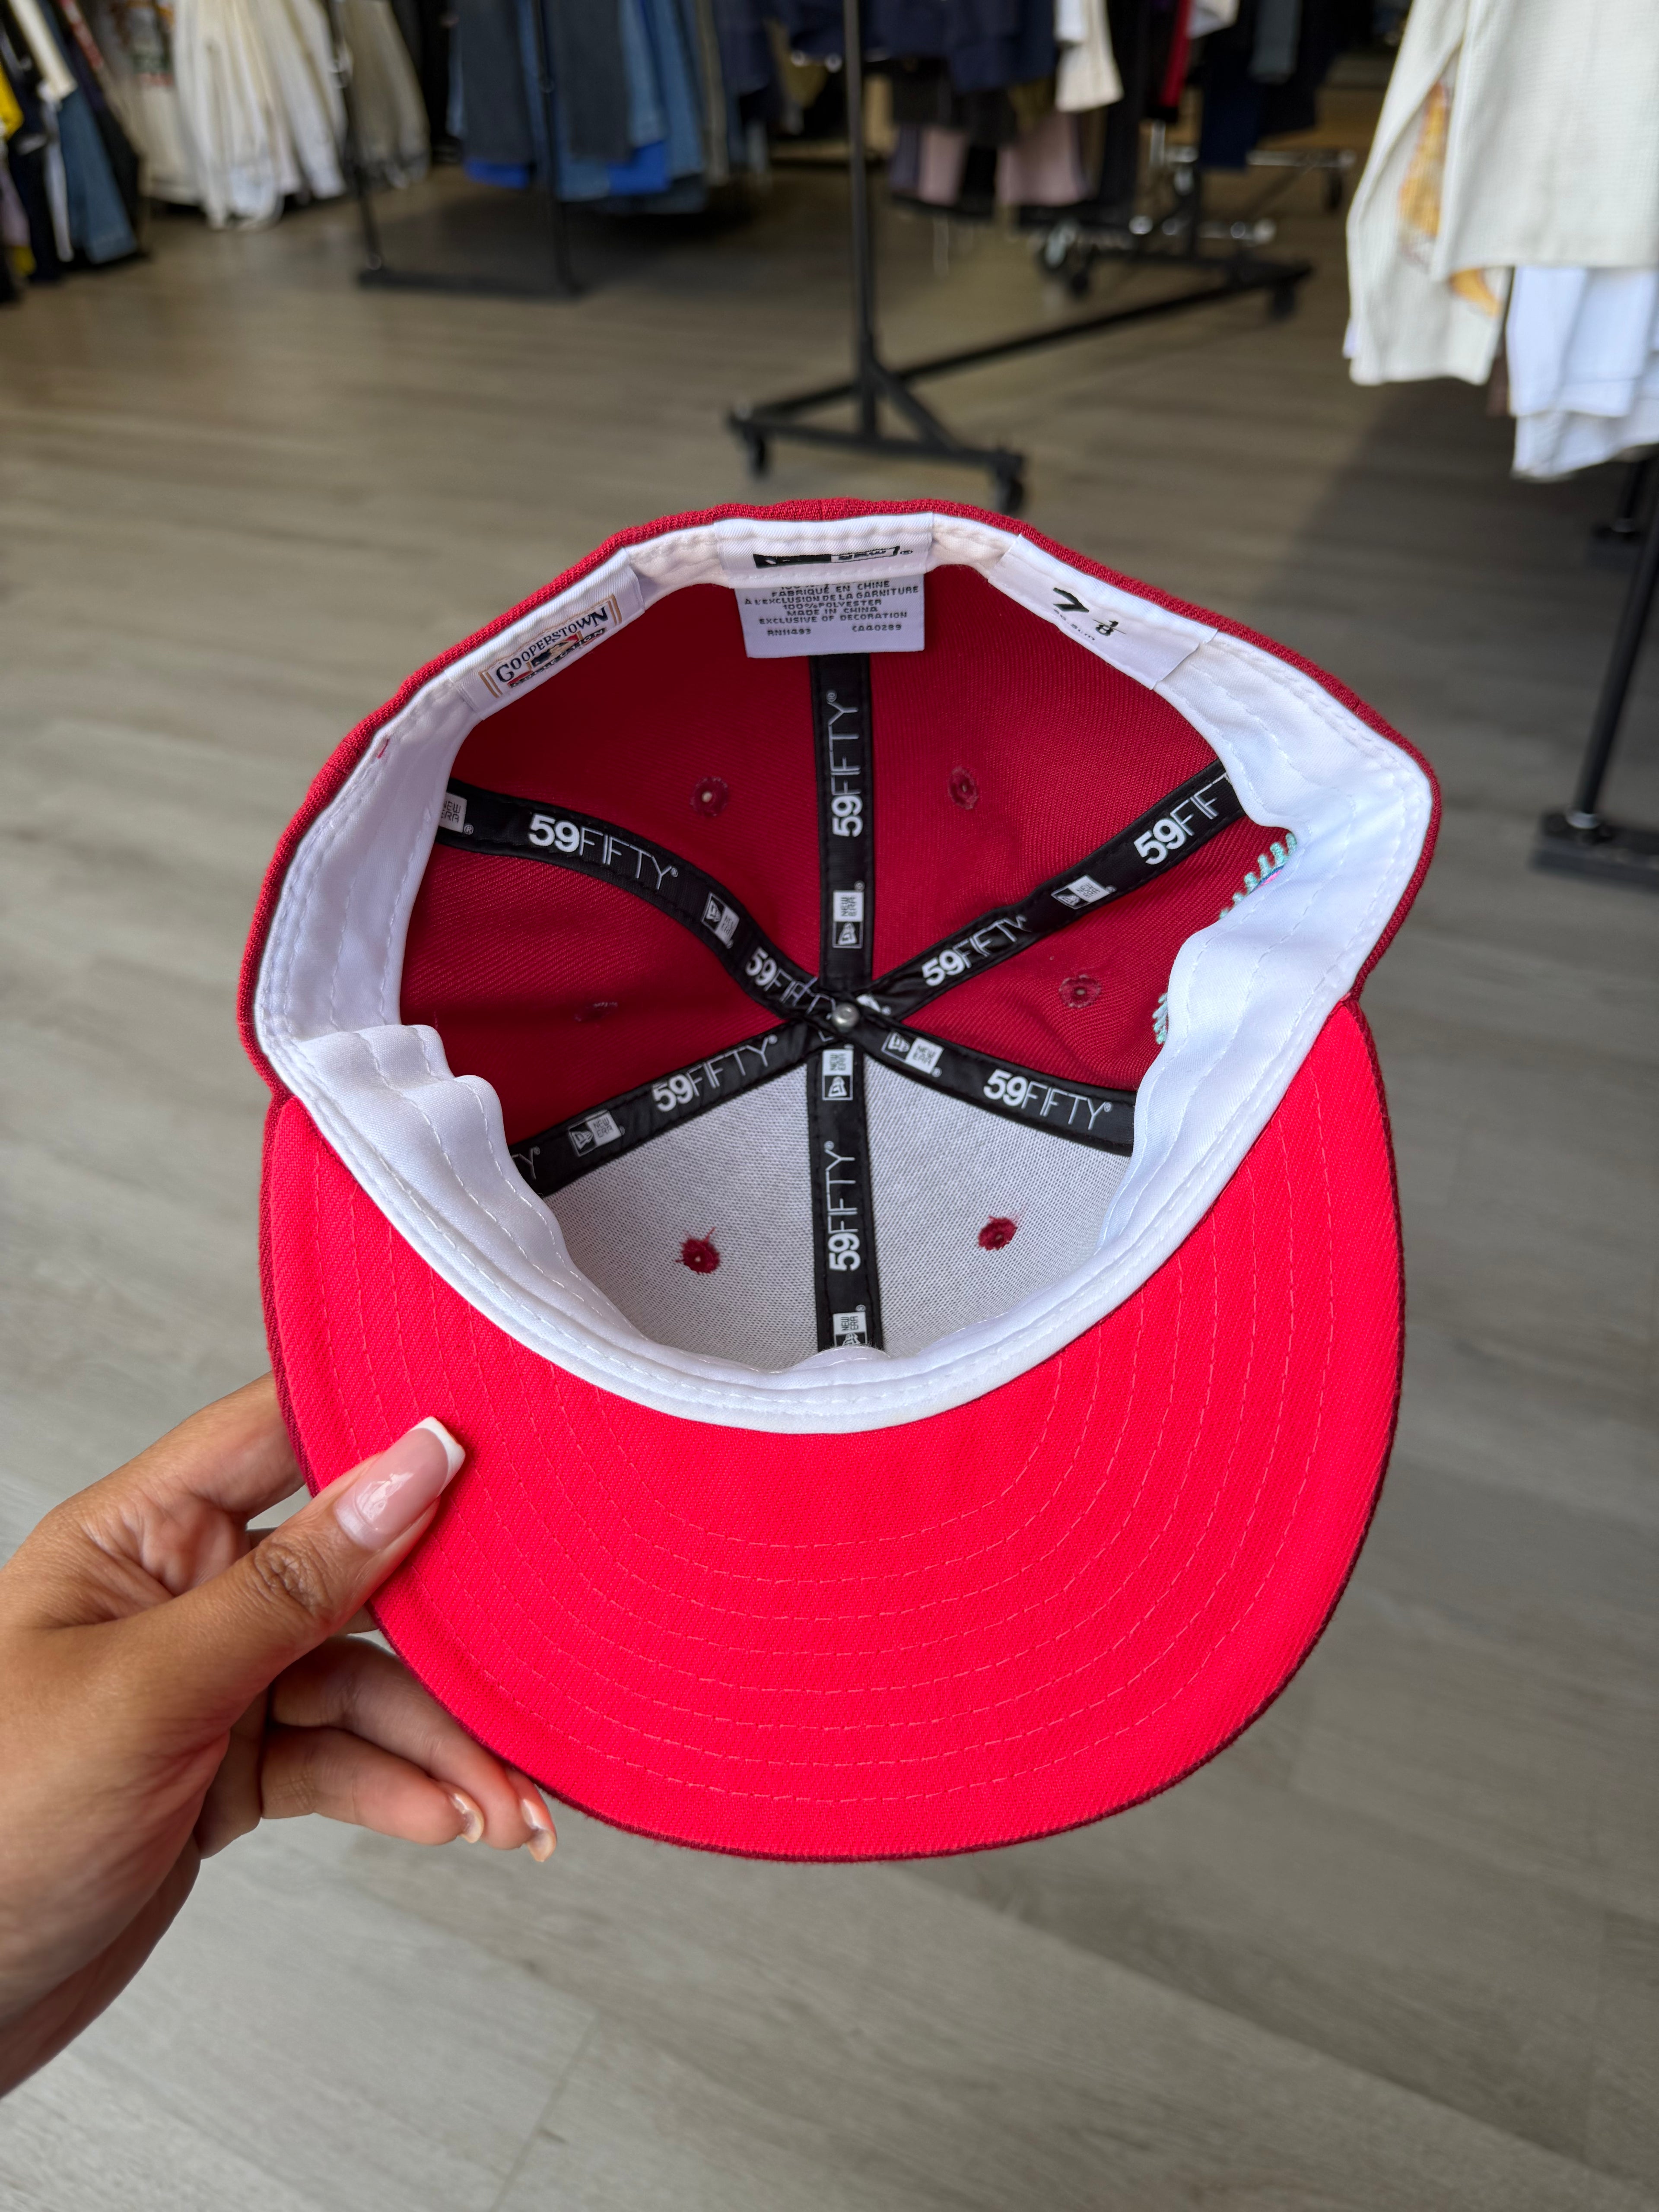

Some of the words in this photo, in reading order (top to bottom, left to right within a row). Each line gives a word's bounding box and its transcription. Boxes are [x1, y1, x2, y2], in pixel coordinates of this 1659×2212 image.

[856, 586, 918, 599] GARNITURE
[858, 581, 890, 591] CHINE
[759, 617, 817, 625] EXCLUSIVE
[840, 612, 907, 621] DECORATION
